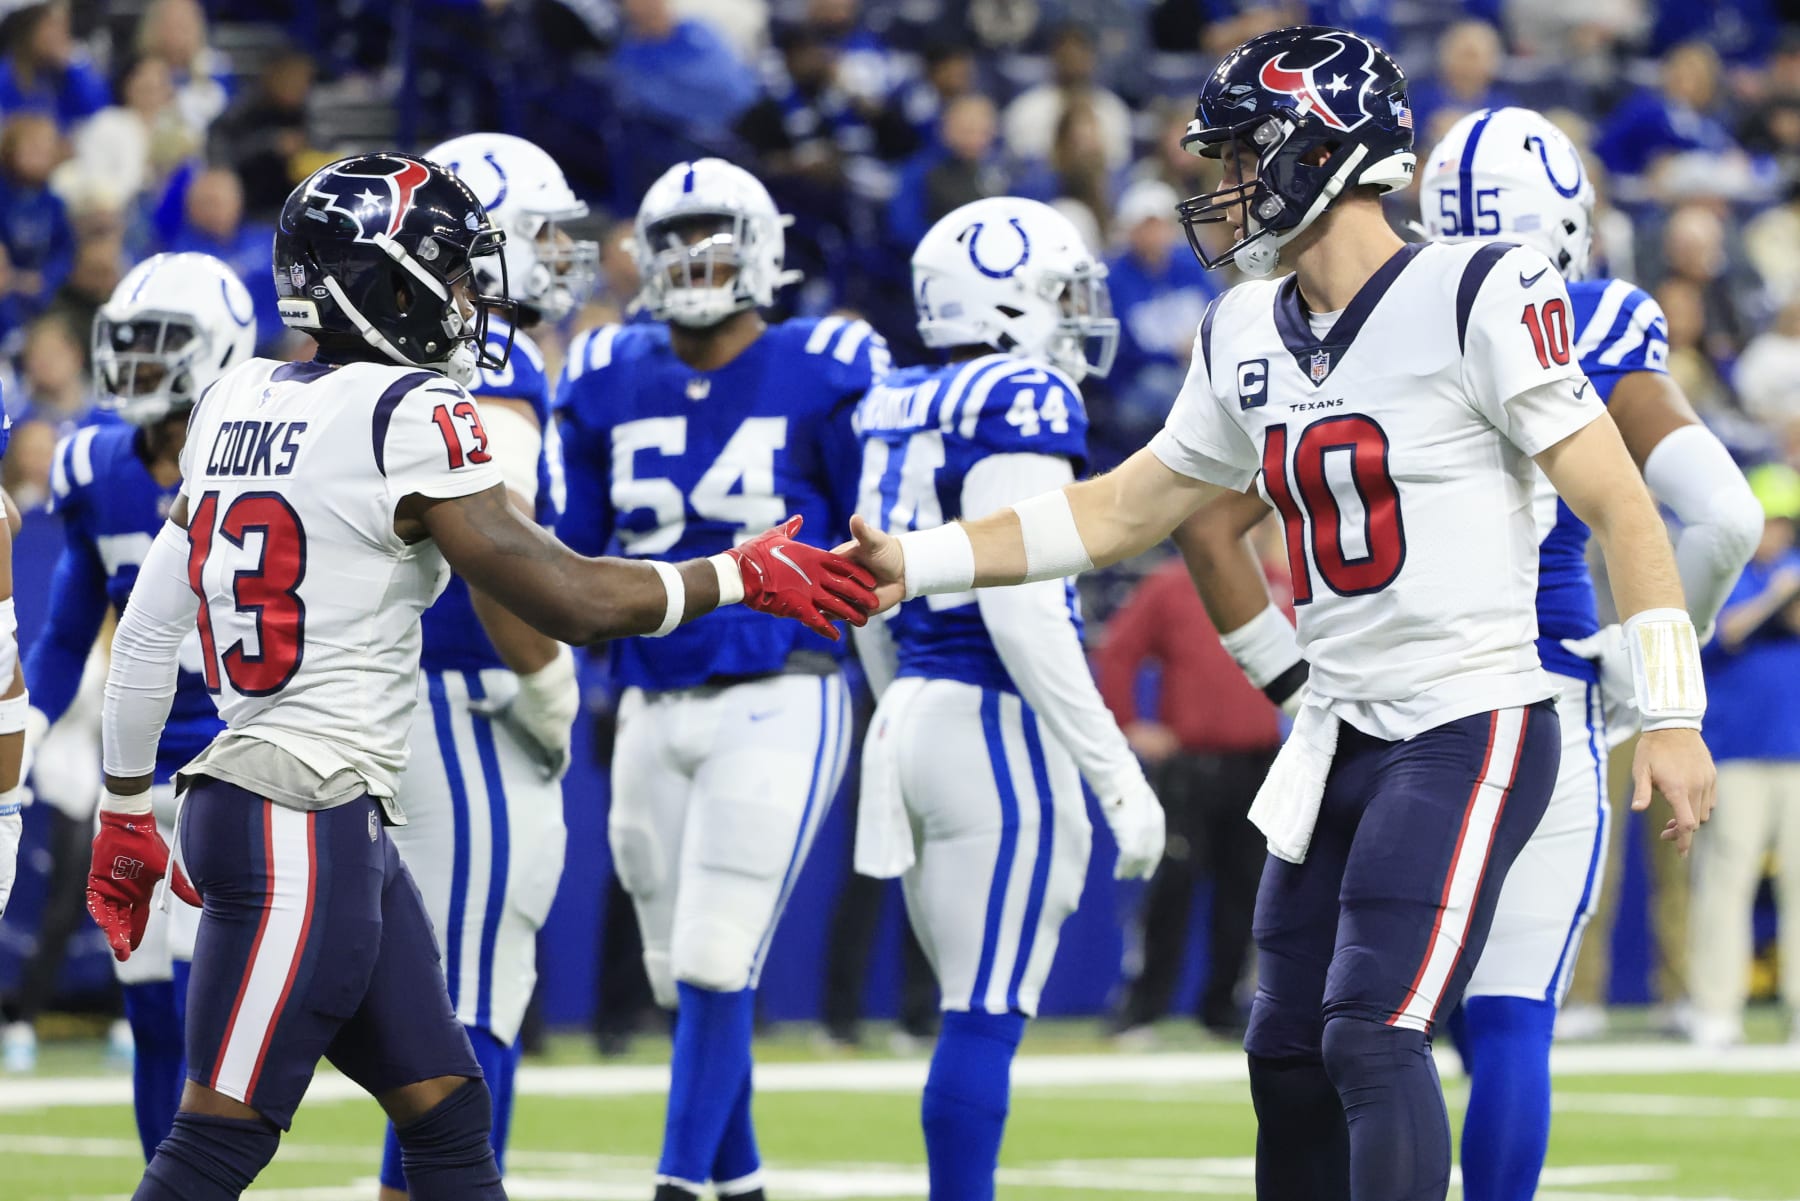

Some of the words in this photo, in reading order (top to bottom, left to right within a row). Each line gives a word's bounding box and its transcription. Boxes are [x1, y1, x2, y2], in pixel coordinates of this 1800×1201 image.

[1440, 189, 1501, 236] 55
[1521, 298, 1569, 369] 10
[1238, 362, 1265, 397] C
[1289, 398, 1344, 413] TEXANS
[432, 402, 492, 469] 13
[1005, 386, 1069, 437] 44
[205, 420, 308, 476] COOKS
[611, 416, 788, 555] 54
[1262, 412, 1406, 607] 10
[188, 490, 307, 697] 13
